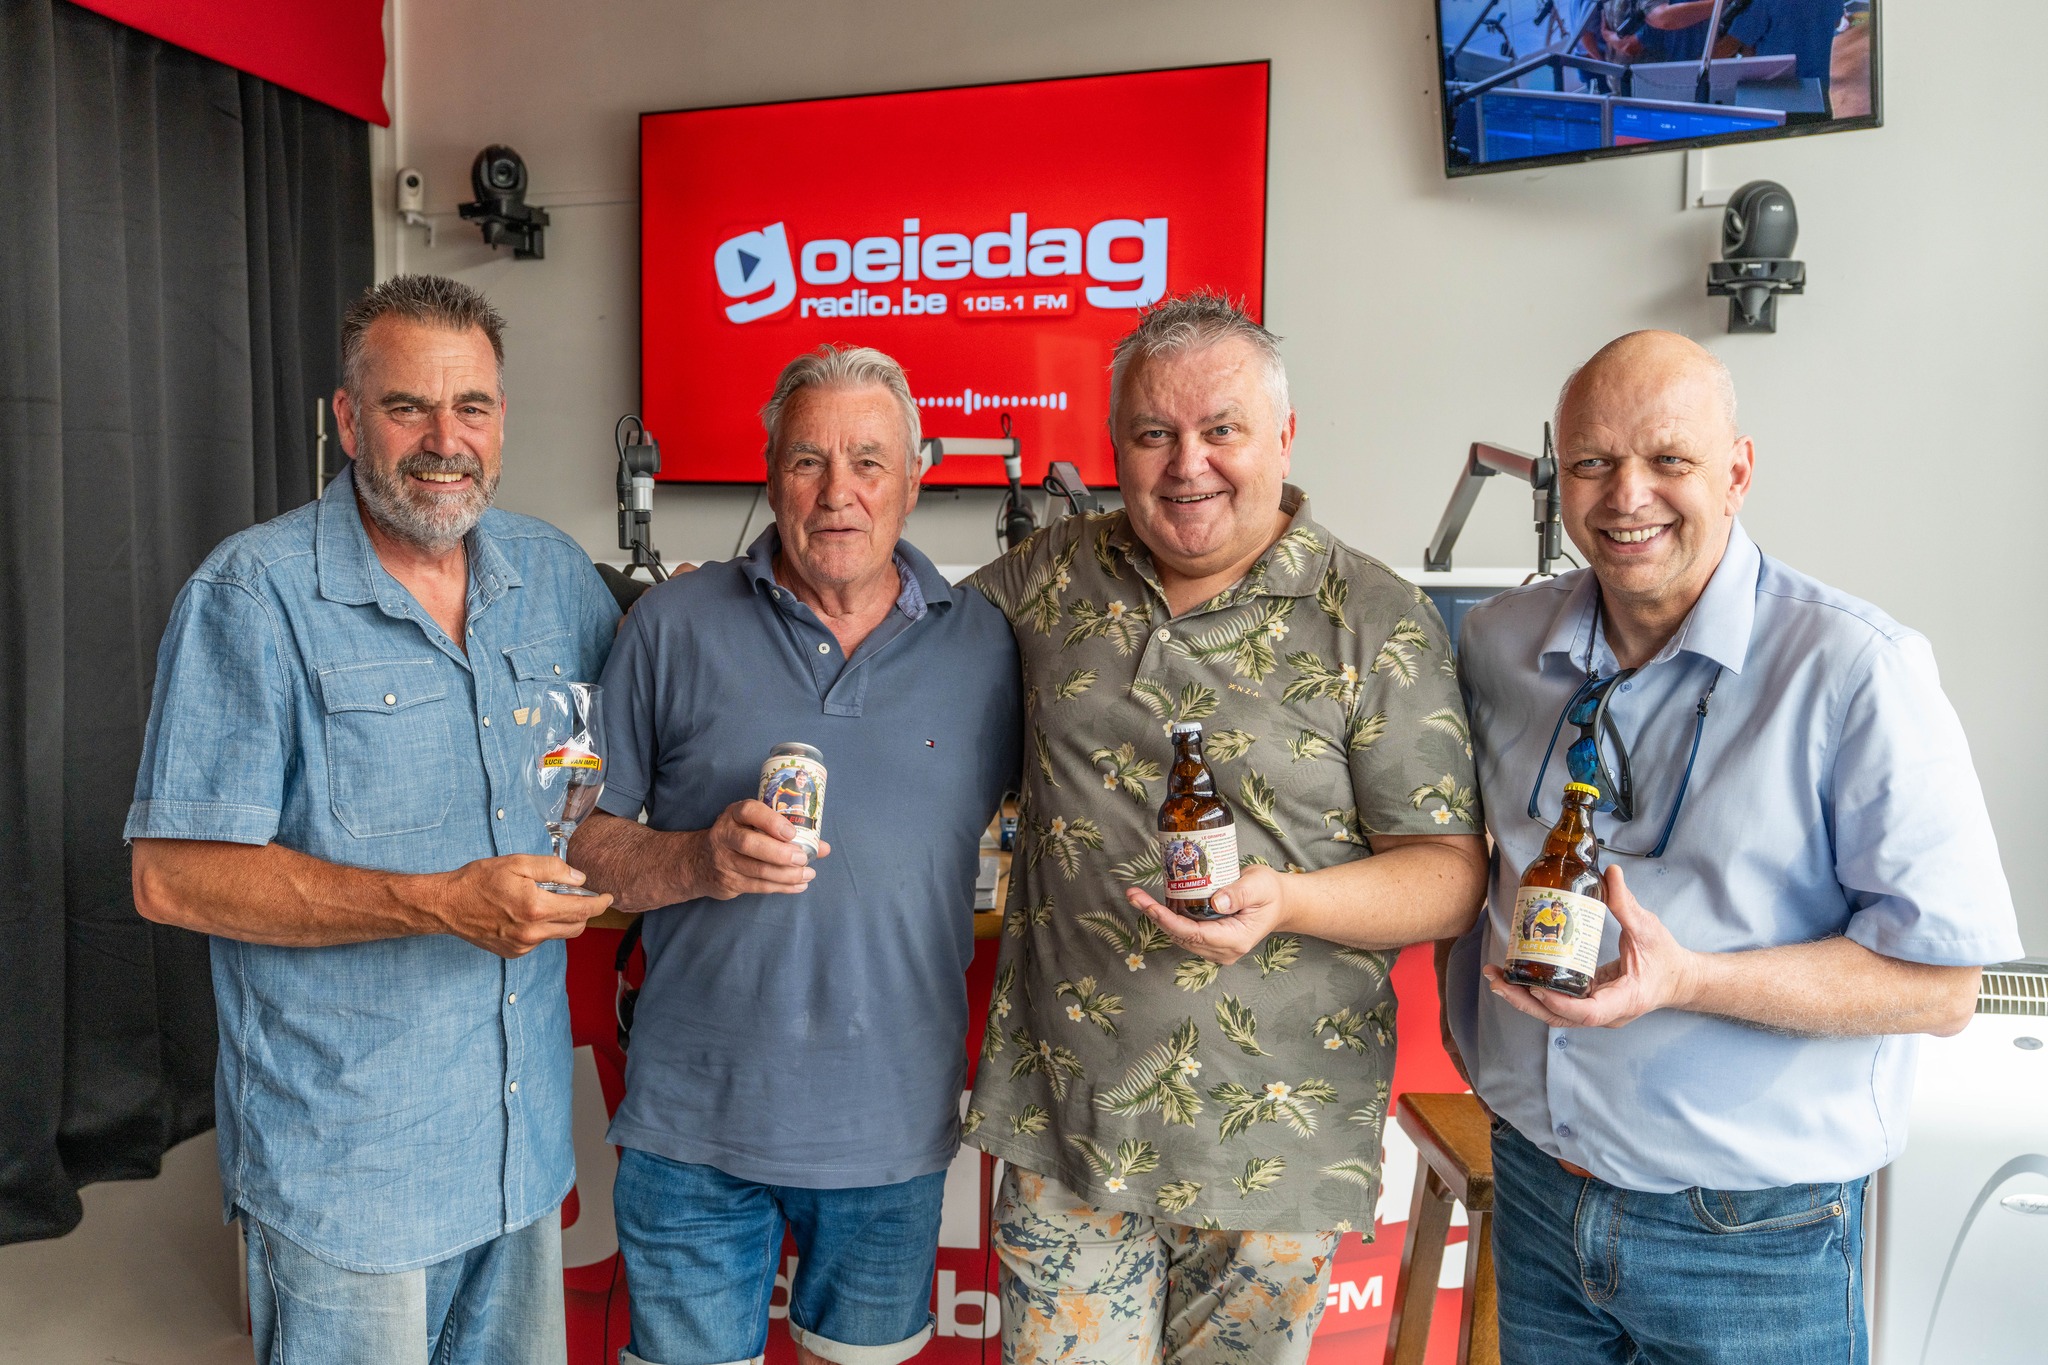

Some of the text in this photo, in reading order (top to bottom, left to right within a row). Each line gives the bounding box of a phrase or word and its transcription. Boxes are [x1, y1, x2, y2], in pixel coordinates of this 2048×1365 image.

[714, 212, 1169, 325] goeiedag
[800, 287, 1067, 318] radio.be 105.1 FM
[1177, 879, 1206, 889] KLIMMER
